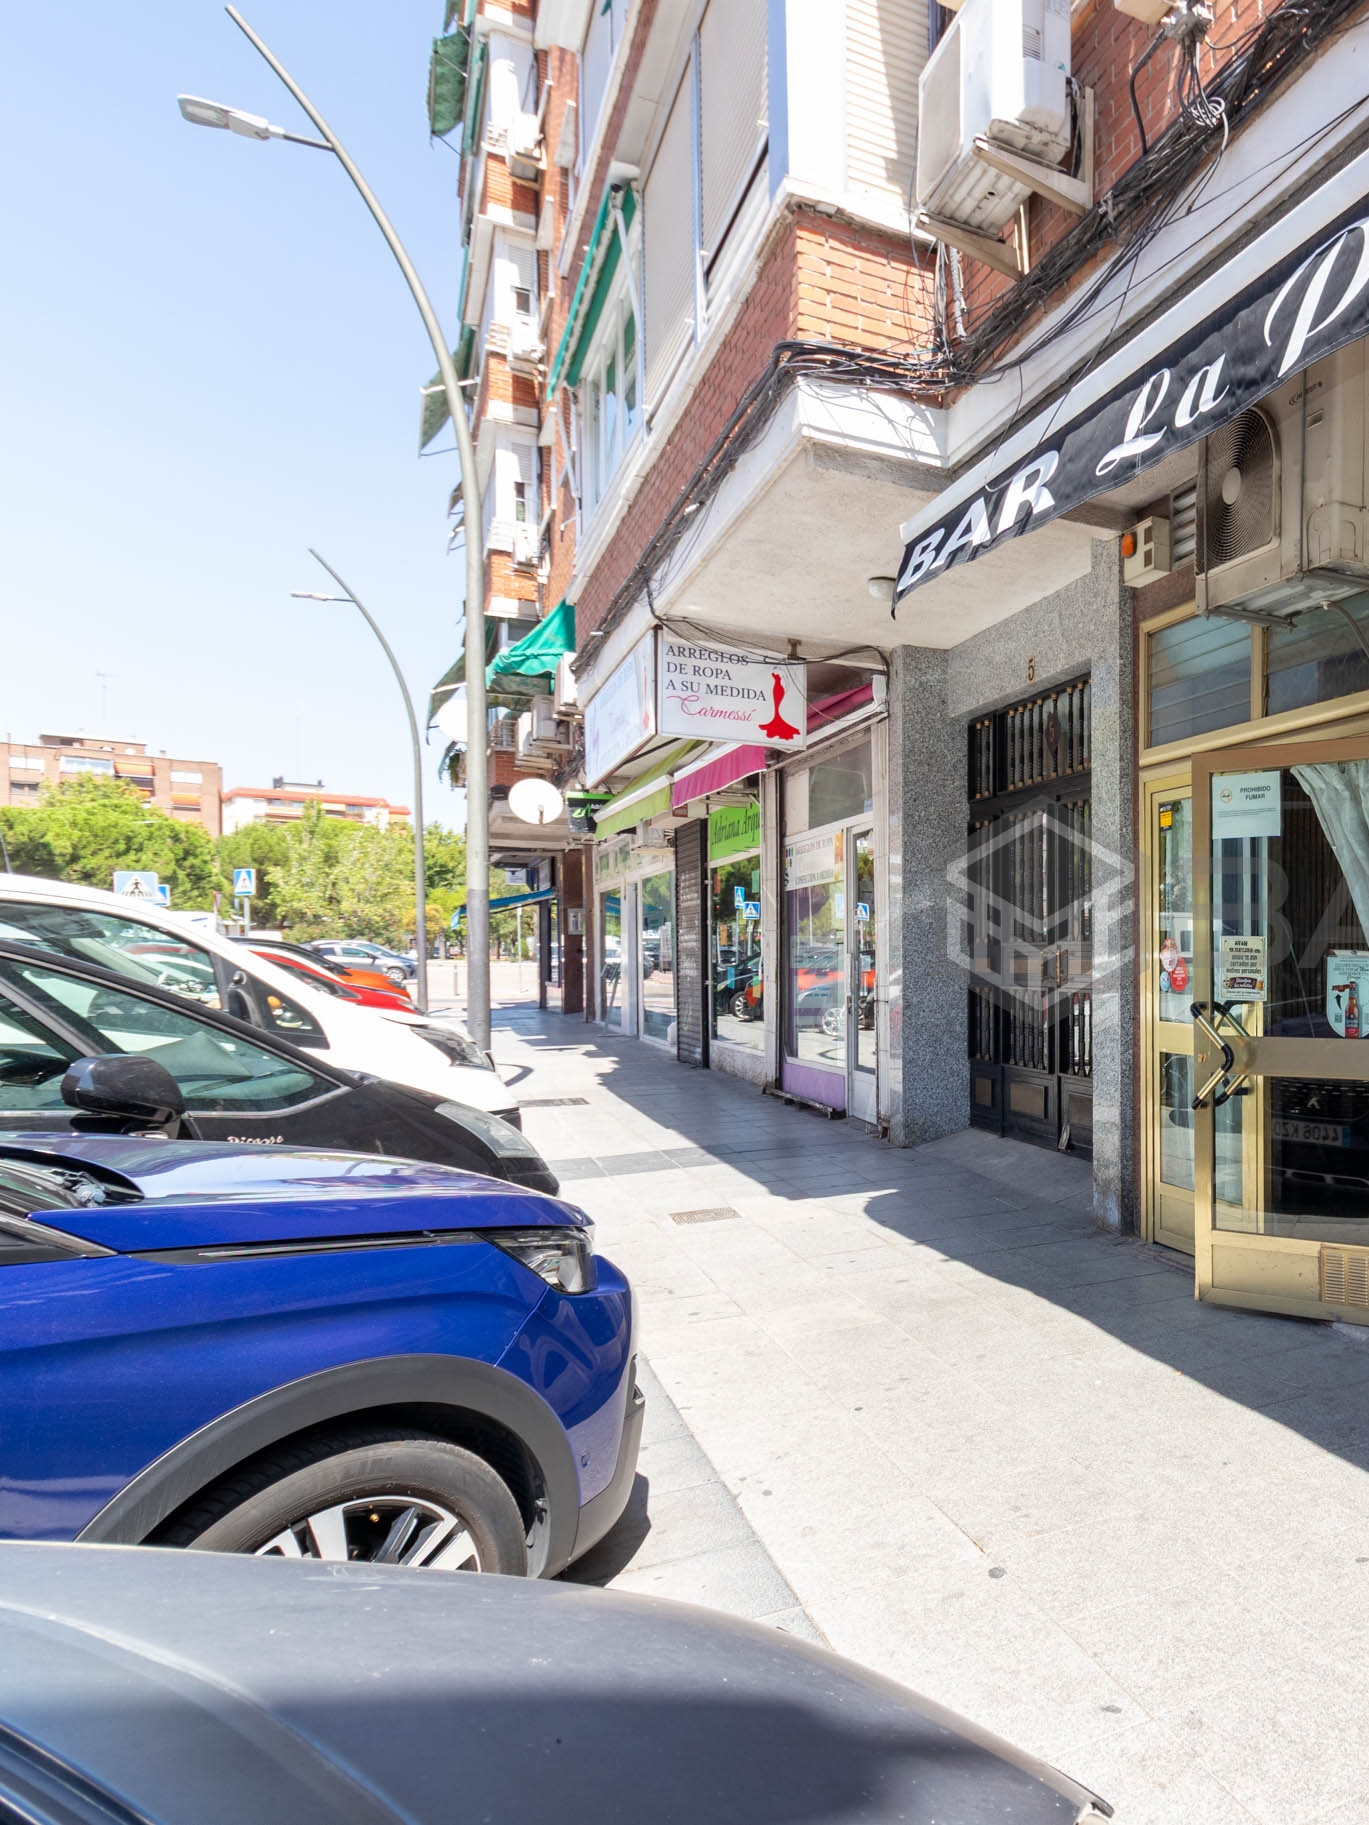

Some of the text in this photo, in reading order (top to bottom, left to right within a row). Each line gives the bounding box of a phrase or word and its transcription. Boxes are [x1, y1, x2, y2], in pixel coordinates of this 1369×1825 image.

[897, 450, 1059, 592] BAR
[1095, 353, 1230, 477] La
[665, 645, 750, 666] ARREGLOS
[667, 661, 732, 681] DE ROPA
[665, 679, 767, 701] A SU MEDIDA
[1240, 785, 1271, 793] PROHIBIDO
[1245, 793, 1265, 801] FUMAR
